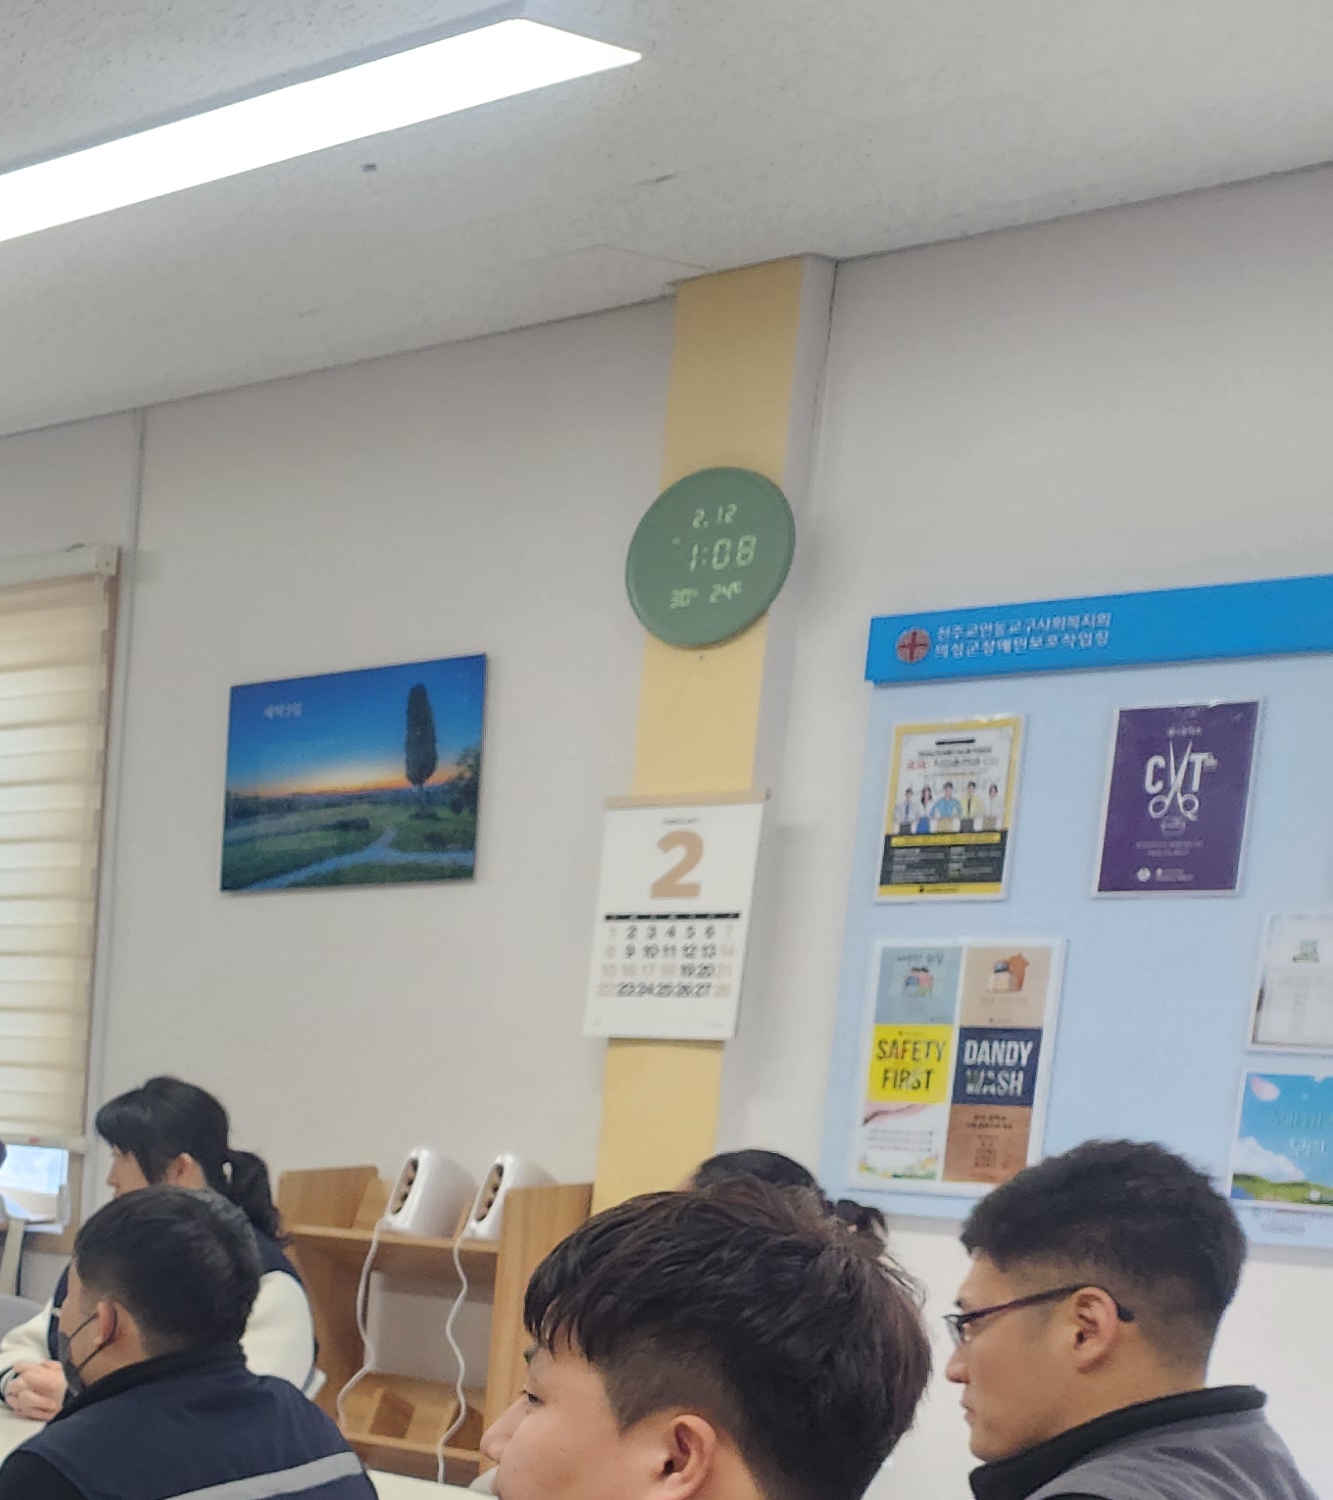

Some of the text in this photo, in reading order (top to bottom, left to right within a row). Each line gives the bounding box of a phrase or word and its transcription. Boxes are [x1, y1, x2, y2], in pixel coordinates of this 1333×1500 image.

[690, 535, 757, 572] 1:08
[651, 829, 704, 899] 2
[876, 1038, 946, 1063] SAFETY
[963, 1038, 1033, 1066] DANDY
[882, 1067, 934, 1091] FIRST
[965, 1067, 1024, 1096] WASH
